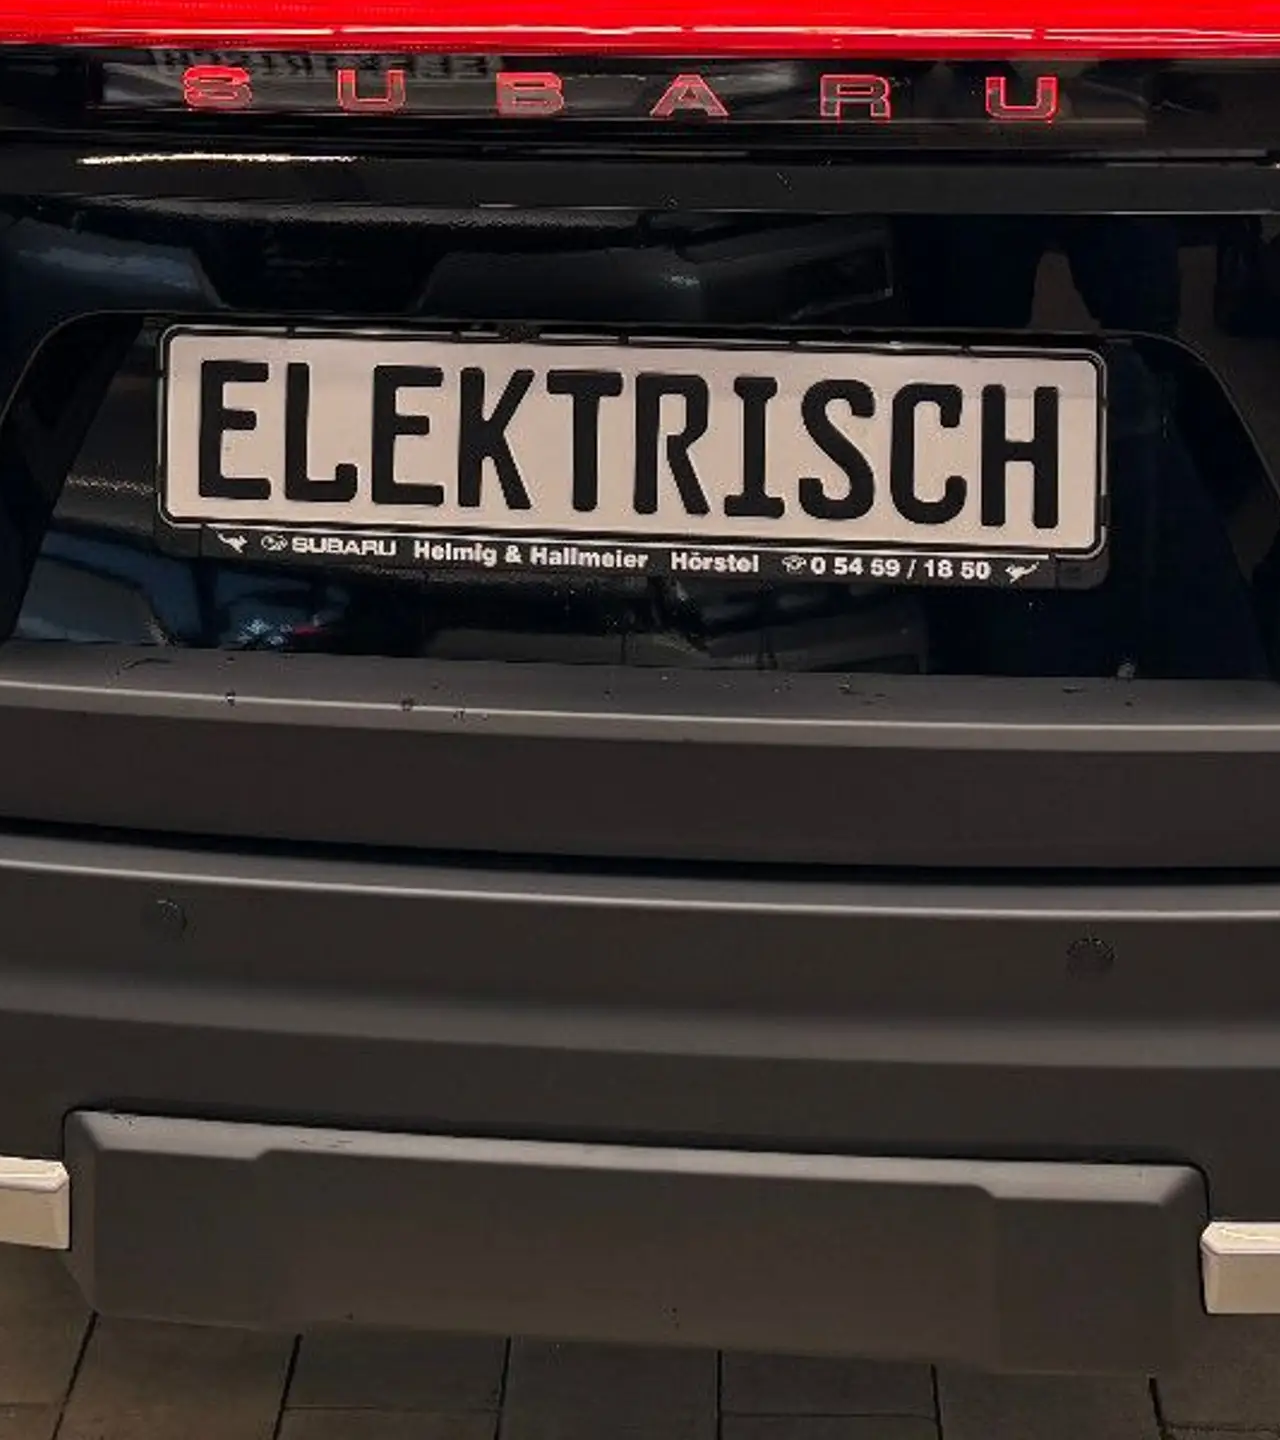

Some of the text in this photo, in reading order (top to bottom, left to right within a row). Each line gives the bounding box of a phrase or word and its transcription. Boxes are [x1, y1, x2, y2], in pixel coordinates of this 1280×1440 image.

[181, 63, 1059, 121] SUBARU
[199, 359, 1059, 529] ELEKTRISCH
[291, 538, 397, 557] SUBARU
[414, 540, 497, 568] Helmig
[504, 545, 522, 564] &
[531, 546, 649, 569] Hallmeier
[670, 551, 759, 573] Hörstel
[810, 558, 825, 575] 0
[833, 557, 864, 576] 54
[870, 559, 901, 578] 59
[925, 560, 953, 579] 18
[961, 561, 992, 580] 50
